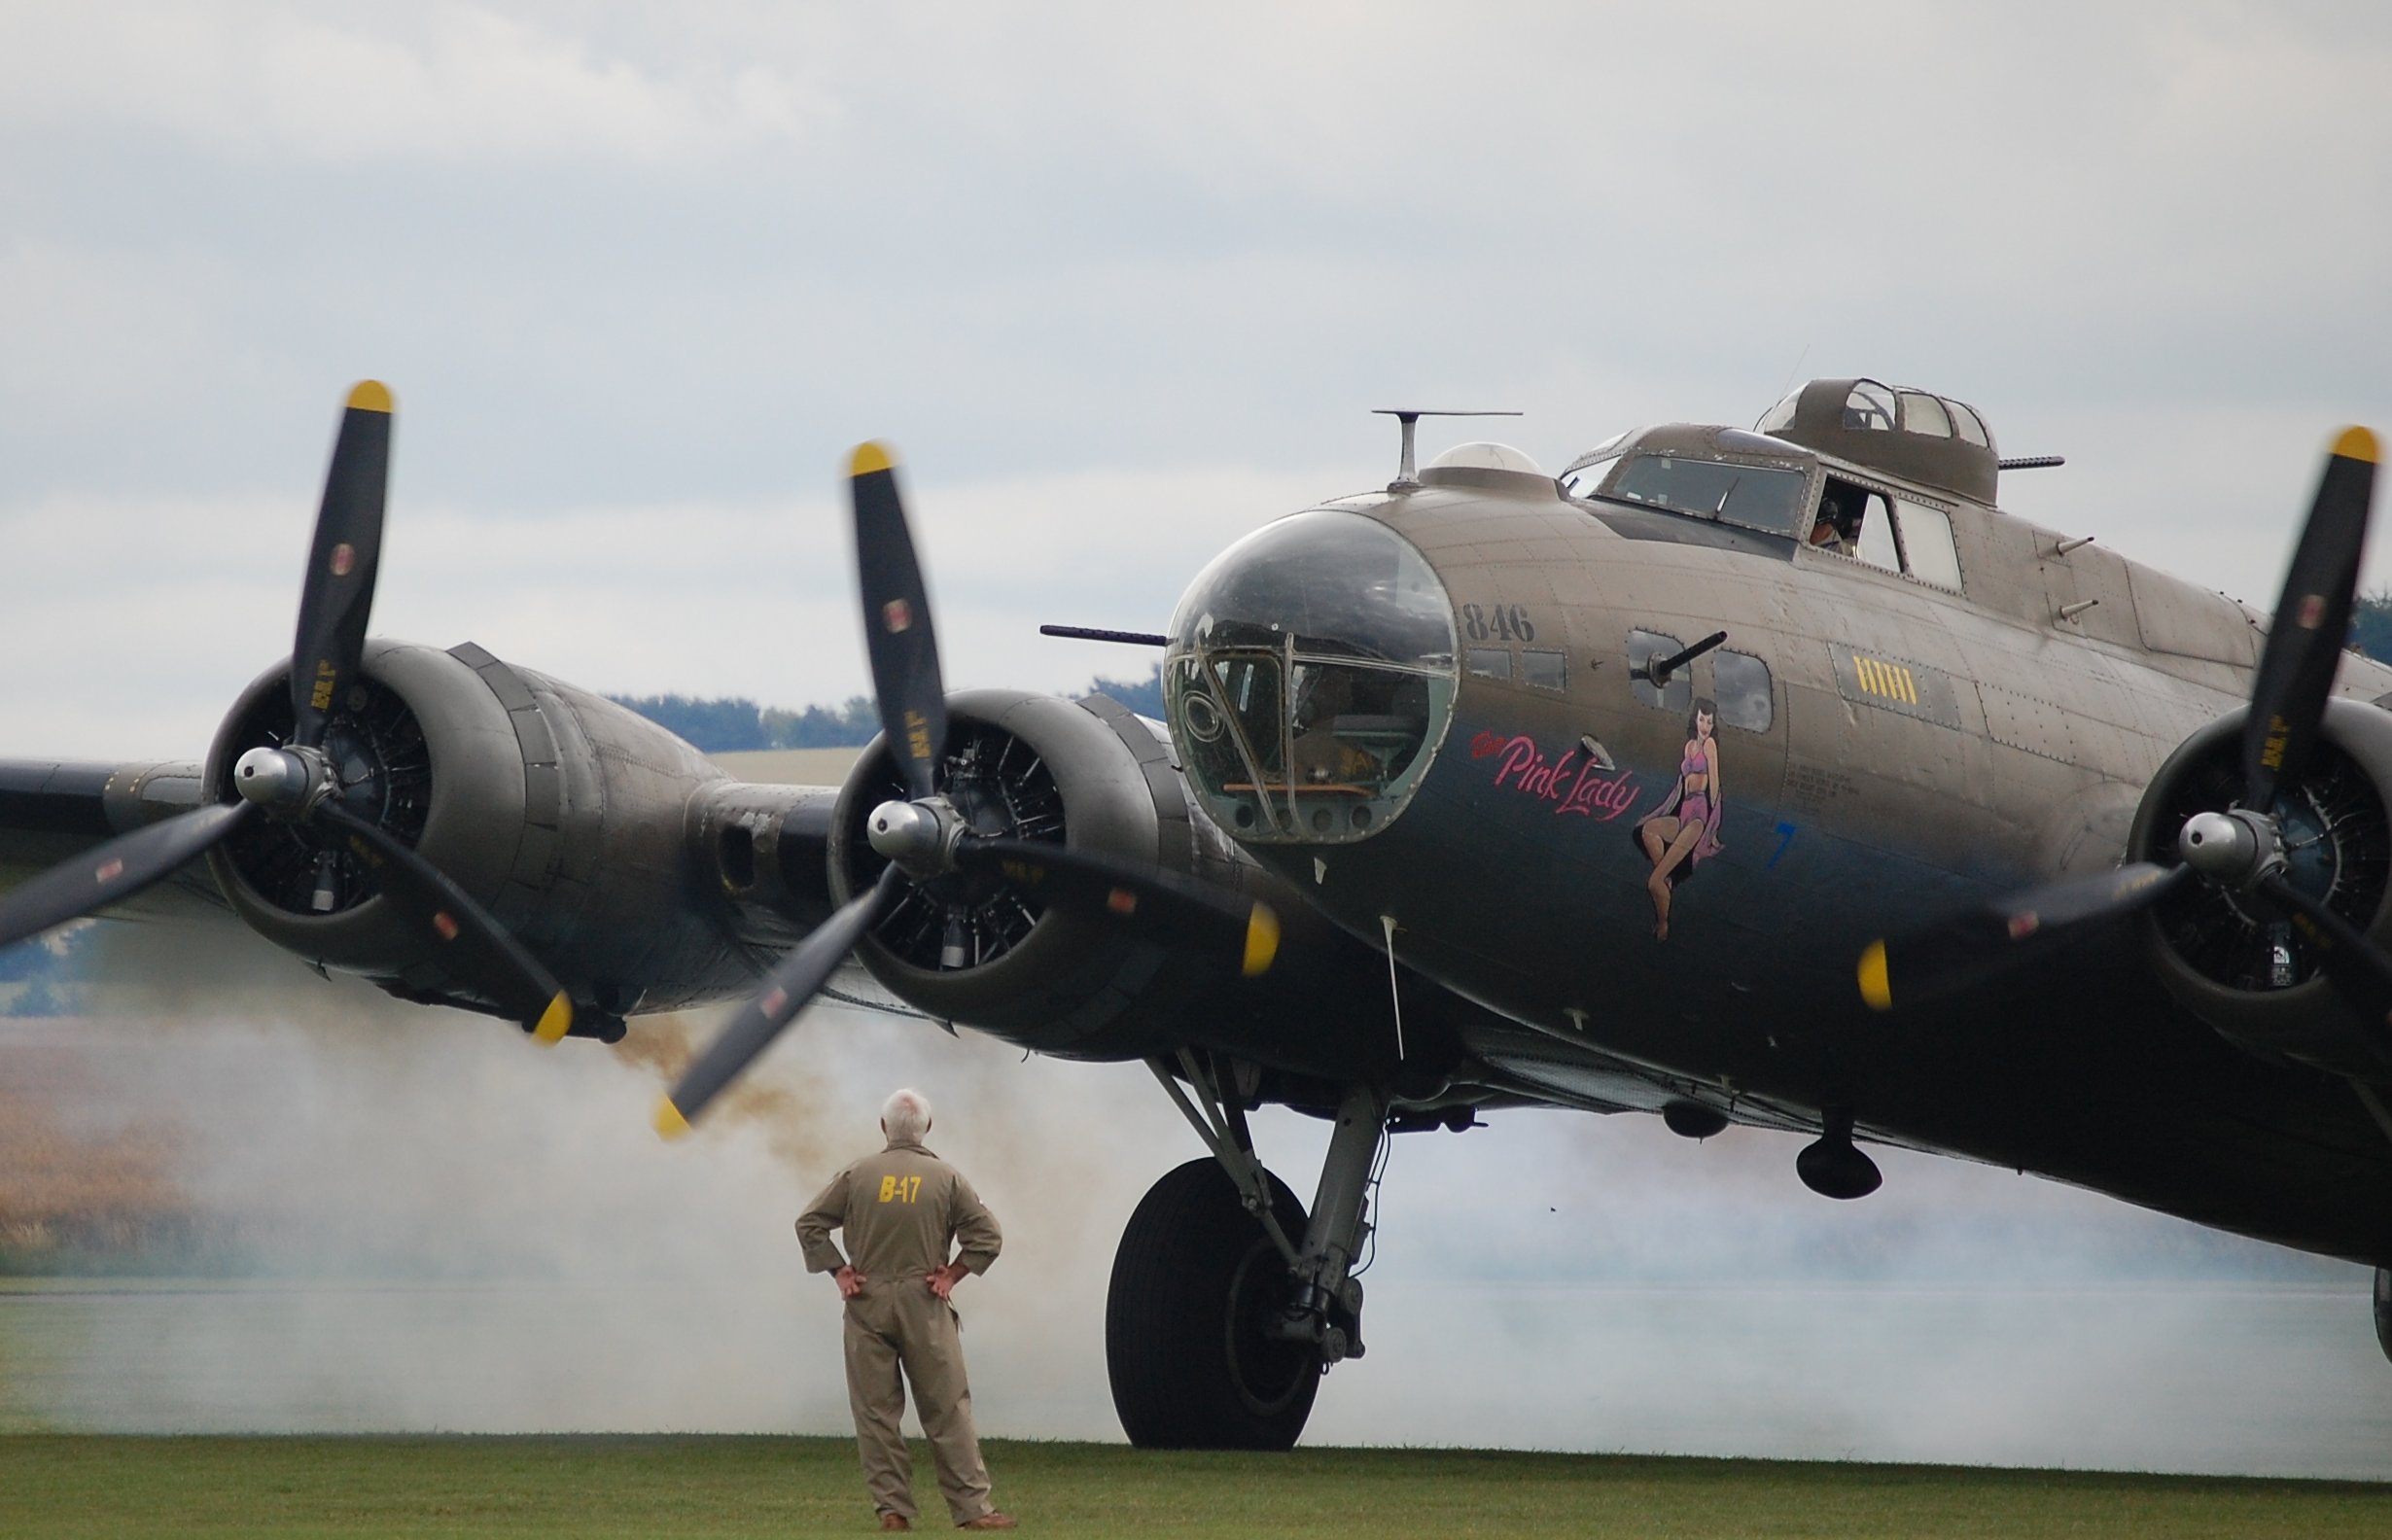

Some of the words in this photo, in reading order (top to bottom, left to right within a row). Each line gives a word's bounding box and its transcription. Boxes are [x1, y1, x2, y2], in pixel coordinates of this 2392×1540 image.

[1462, 603, 1534, 643] 846
[1495, 734, 1575, 801] Pink
[1556, 755, 1641, 822] Lady
[878, 1174, 922, 1204] B-17
